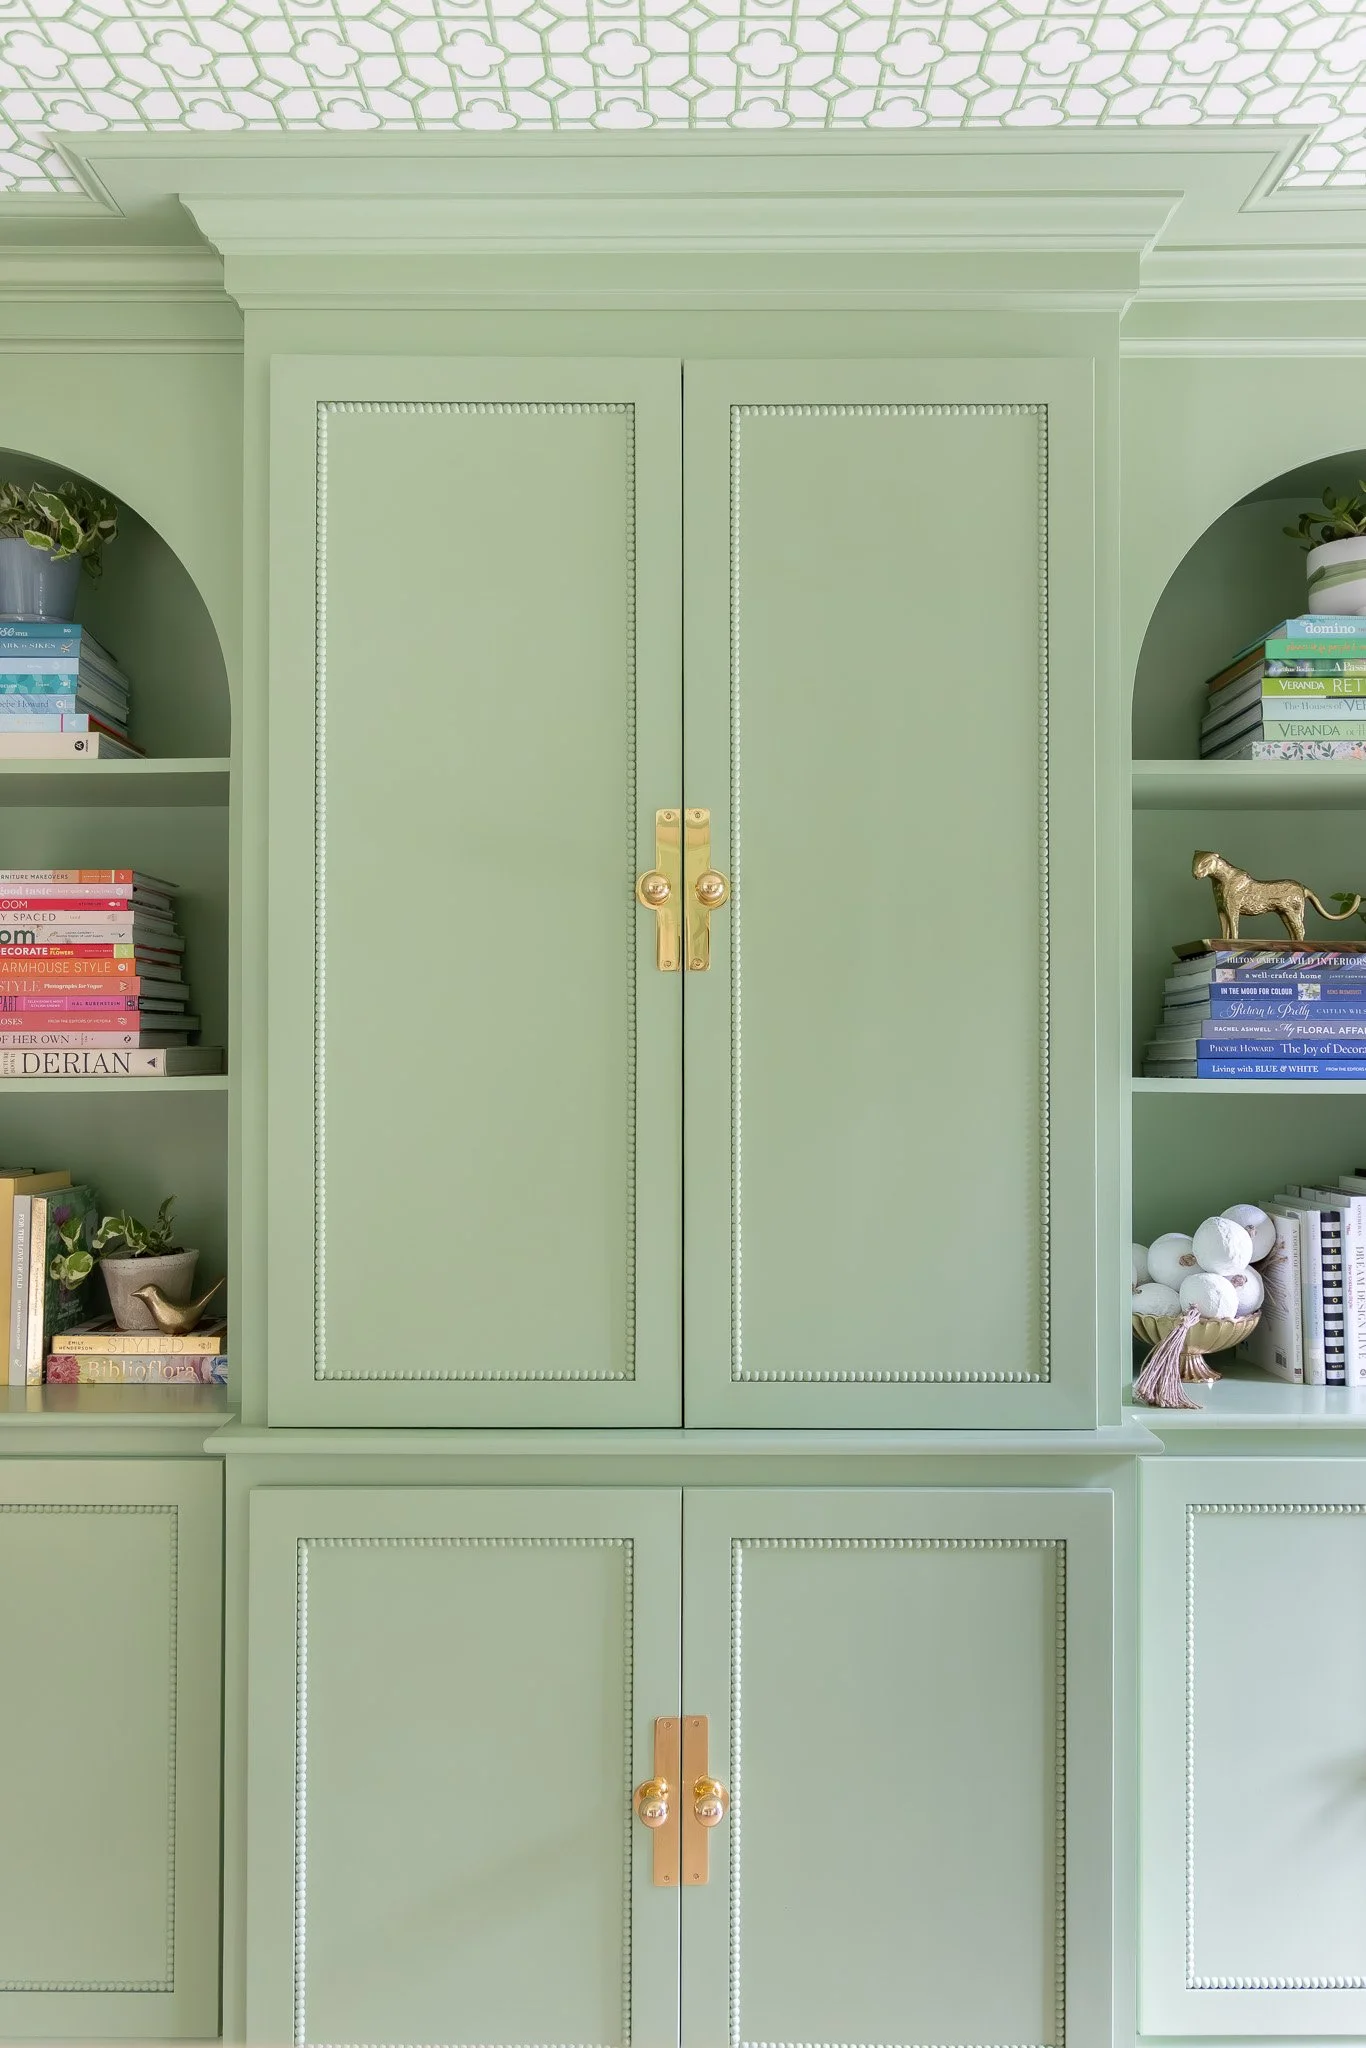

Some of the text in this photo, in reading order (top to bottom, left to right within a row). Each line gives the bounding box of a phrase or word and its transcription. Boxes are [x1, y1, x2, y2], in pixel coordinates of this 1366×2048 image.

[1305, 622, 1356, 634] domino
[1279, 679, 1366, 693] VERANDA RET
[1283, 701, 1300, 710] The
[1278, 724, 1341, 737] VERANDA
[0, 900, 28, 910] OOM
[13, 913, 56, 921] SPACED
[74, 961, 111, 973] STYLE
[1288, 957, 1314, 965] WILD
[1317, 957, 1366, 966] INTERIORS
[1251, 971, 1298, 979] well-crafted
[1220, 1000, 1313, 1020] Return to Pretty
[1280, 1023, 1296, 1038] My
[1296, 1026, 1336, 1034] FLORAL
[12, 1034, 38, 1044] HER
[40, 1034, 70, 1045] OWN
[1240, 1044, 1275, 1052] HOWARD
[1279, 1043, 1301, 1054] The
[1302, 1043, 1319, 1057] Joy
[1320, 1043, 1332, 1054] of
[22, 1052, 132, 1074] DERIAN
[1212, 1065, 1319, 1074] Living with BLUE & WHITE
[16, 1273, 24, 1289] OLD
[1356, 1246, 1366, 1360] DREAM DESIGN LIVE
[107, 1337, 184, 1353] STYLED
[88, 1360, 195, 1380] Biblioflora
